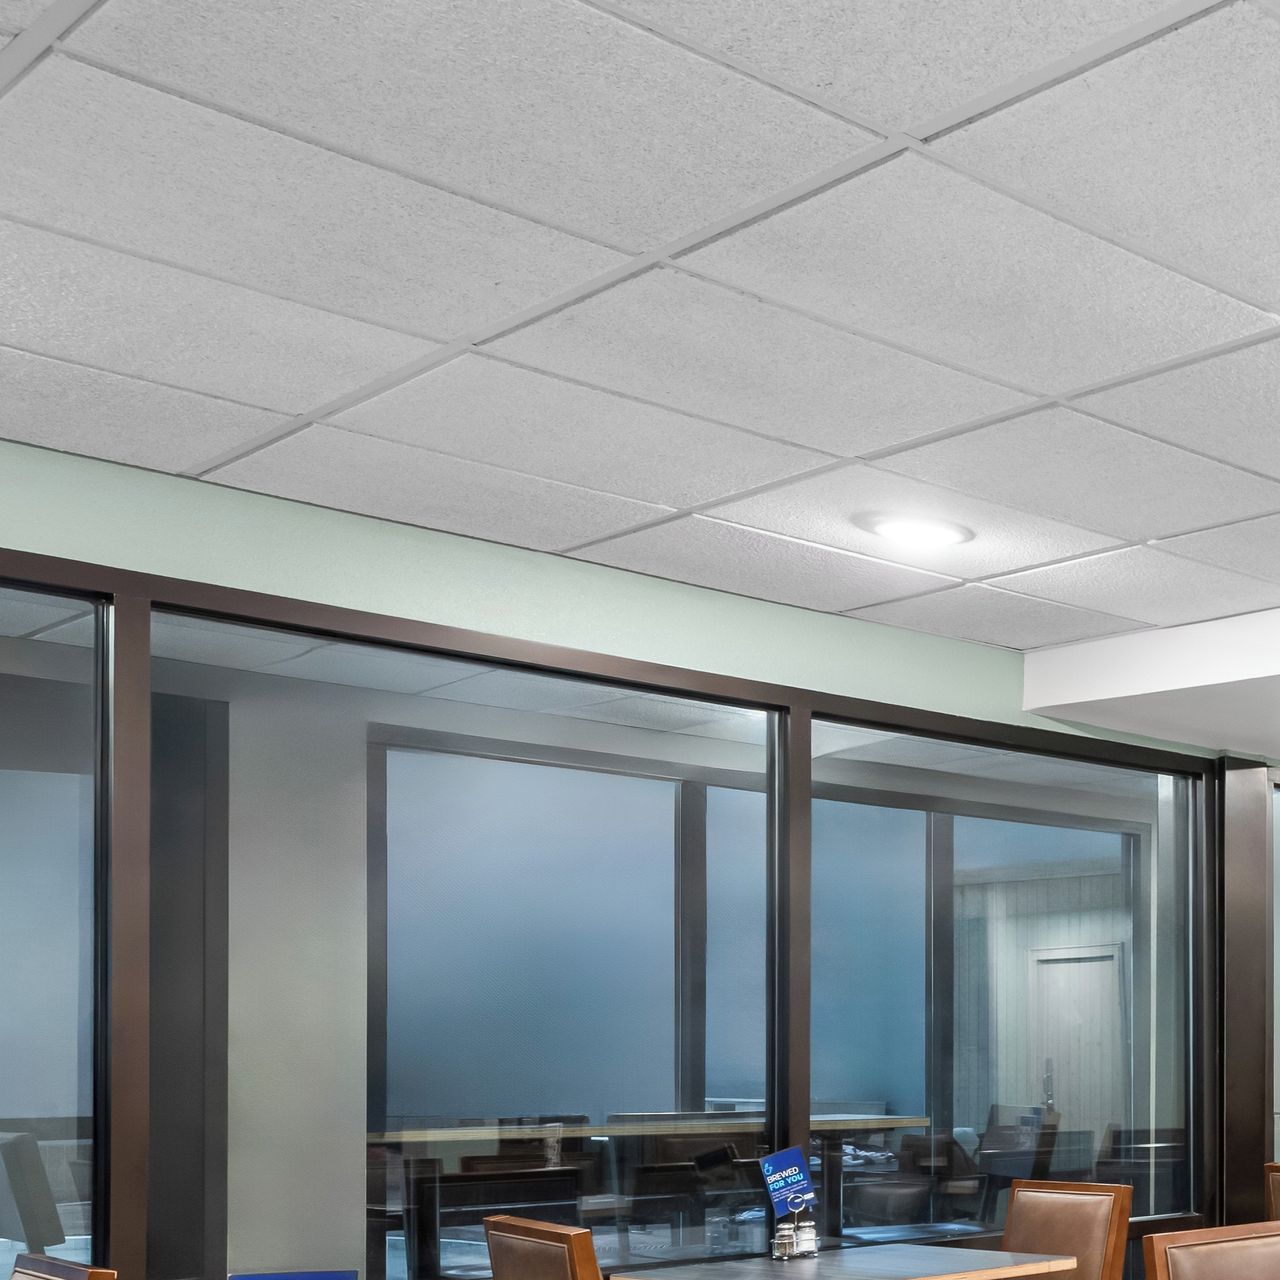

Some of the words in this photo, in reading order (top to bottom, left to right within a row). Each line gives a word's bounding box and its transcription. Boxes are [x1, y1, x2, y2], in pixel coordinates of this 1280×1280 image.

[767, 1167, 799, 1183] BREWED
[769, 1179, 785, 1191] FOR
[786, 1173, 804, 1183] YOU
